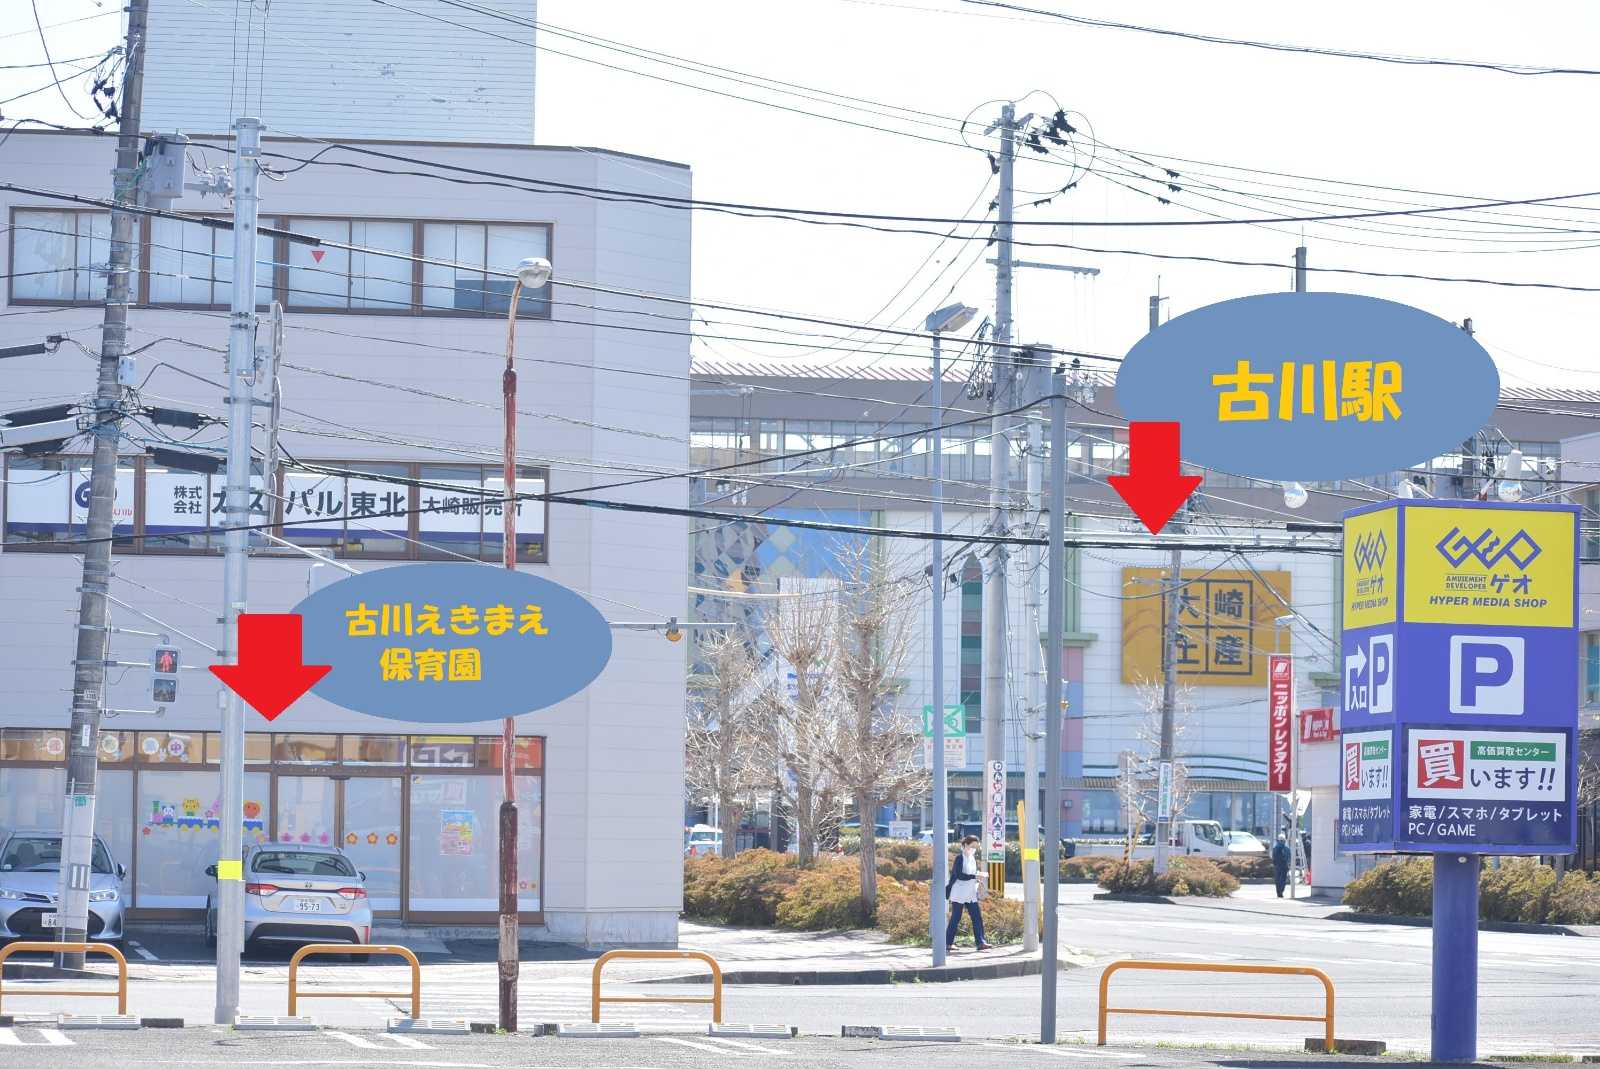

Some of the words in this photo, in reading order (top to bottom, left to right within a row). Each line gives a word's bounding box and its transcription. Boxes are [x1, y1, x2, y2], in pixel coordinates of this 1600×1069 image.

[174, 485, 202, 499] 株式
[174, 500, 202, 514] 会社
[1446, 575, 1487, 583] AMUSEMENT
[1446, 582, 1487, 590] DEVELOPER
[1490, 573, 1532, 594] ゲオ
[1178, 588, 1244, 619] 大崎
[1429, 596, 1469, 606] HYPER
[1472, 597, 1510, 607] MEDIA
[1514, 599, 1548, 608] SHOP
[1373, 642, 1390, 707] P
[1460, 643, 1514, 706] P
[1351, 686, 1368, 710] 入口
[1273, 683, 1288, 785] ニッポンレンタカー
[1477, 745, 1550, 757] 高価買取センター
[1408, 805, 1562, 822] 家電/スマホ/タブレット
